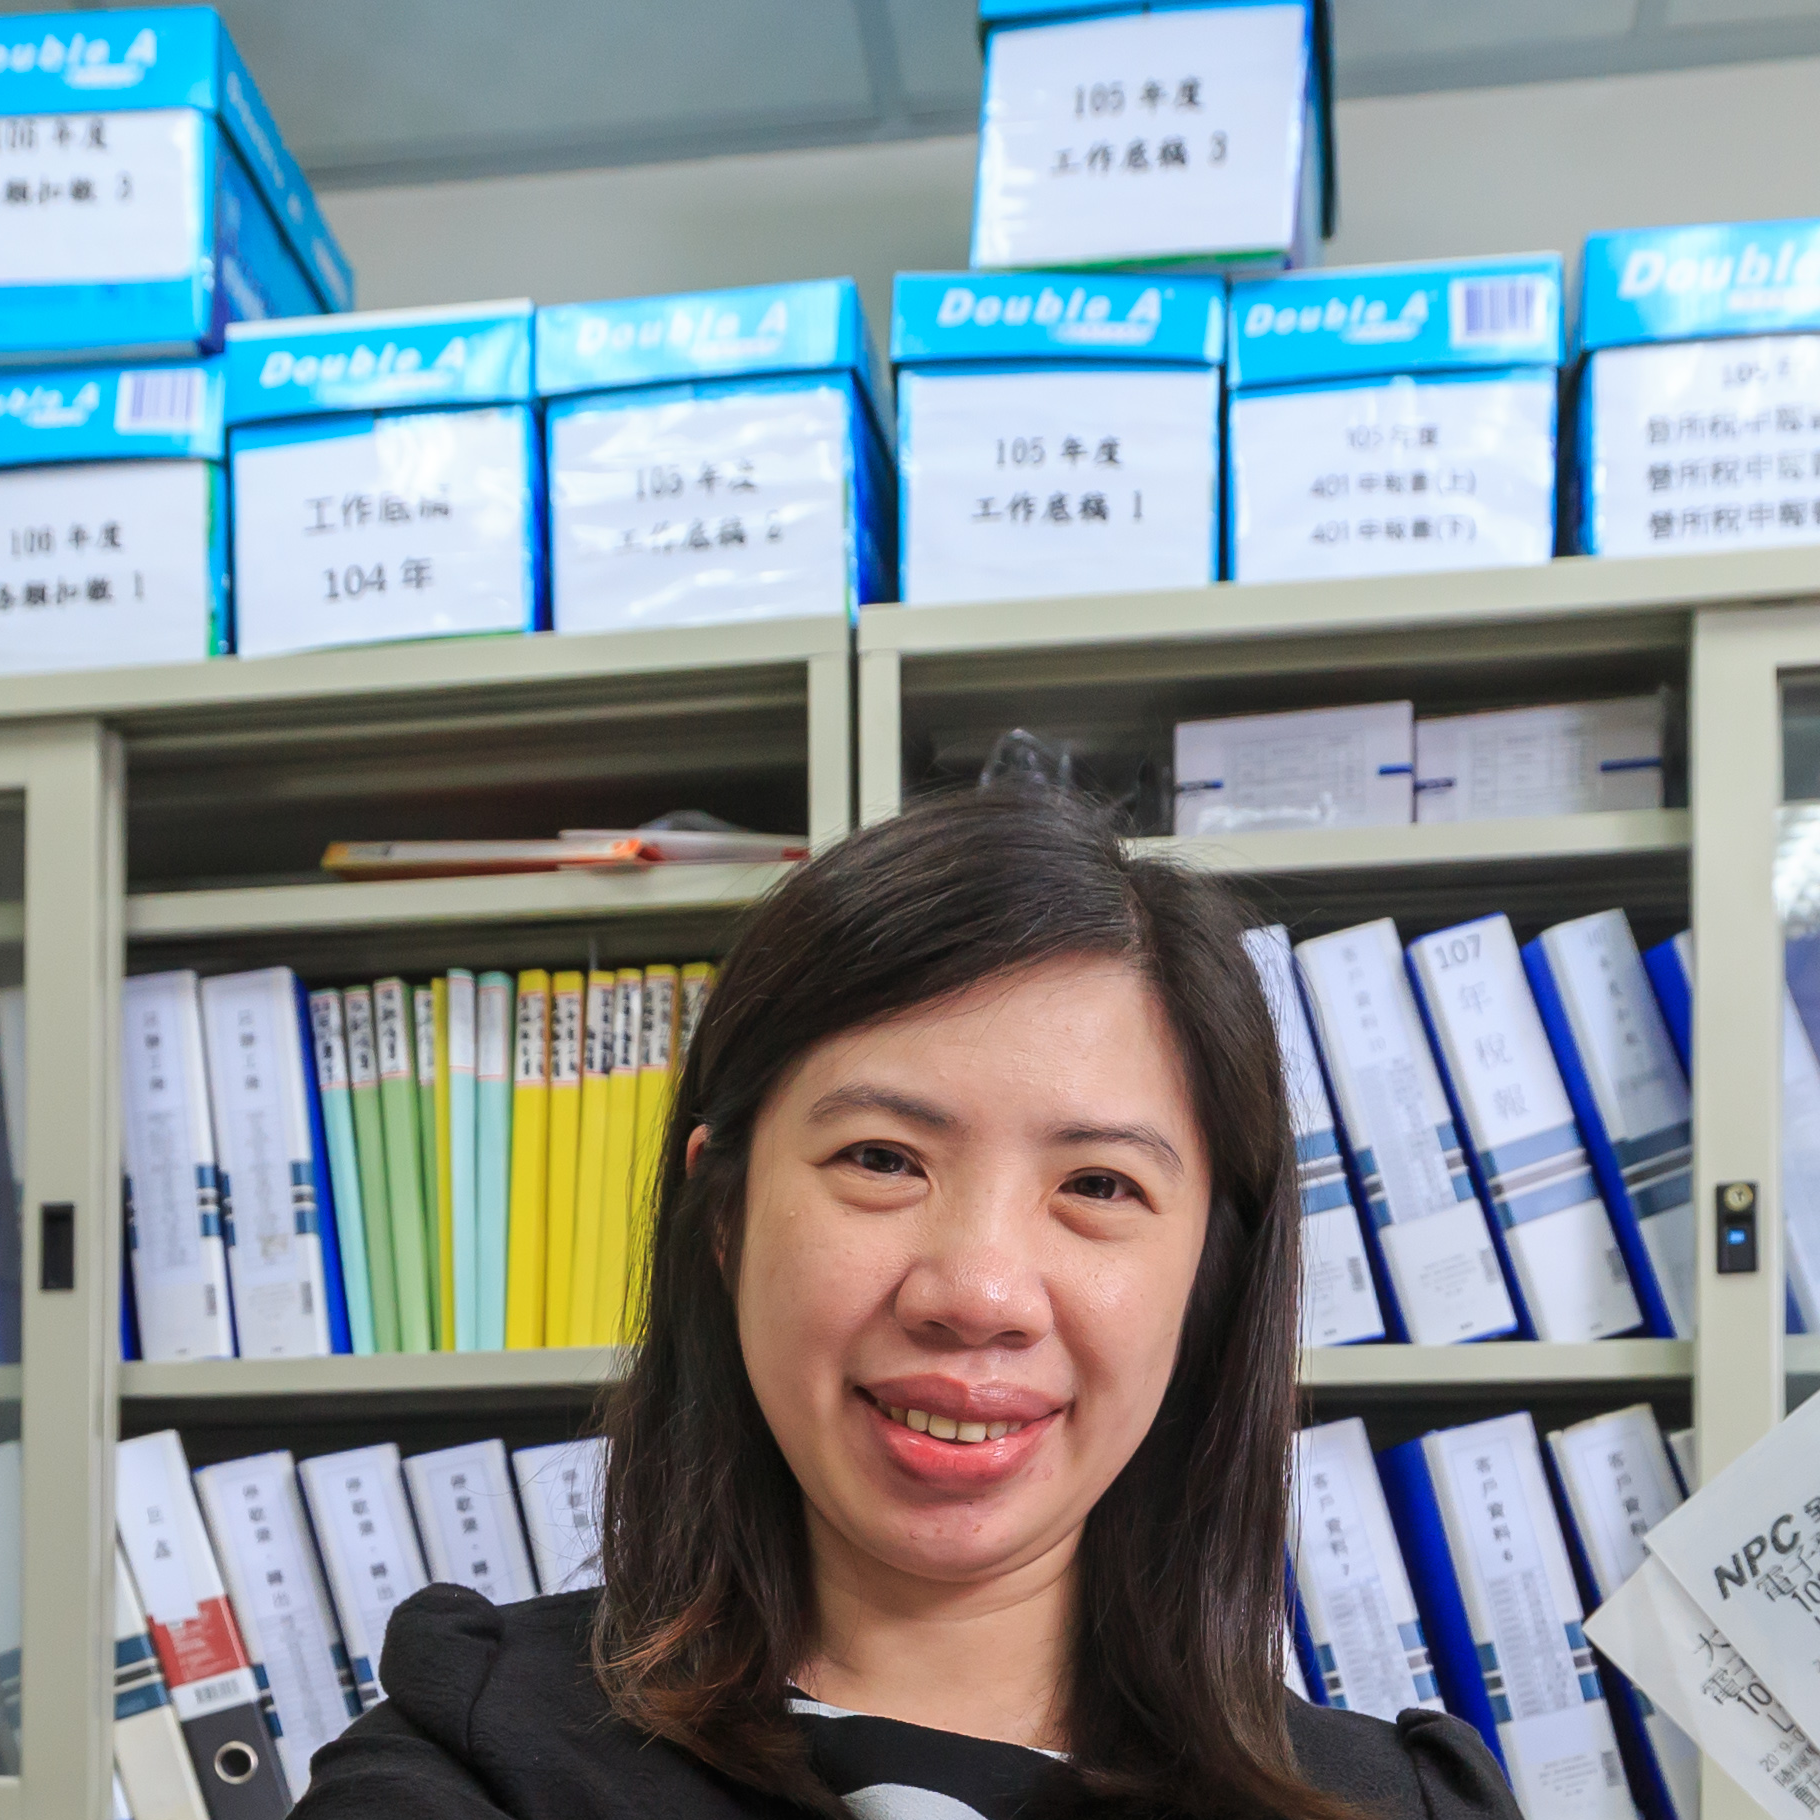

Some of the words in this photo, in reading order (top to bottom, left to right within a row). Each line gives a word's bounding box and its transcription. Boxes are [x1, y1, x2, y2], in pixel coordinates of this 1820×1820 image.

[125, 28, 158, 67] A
[1073, 82, 1126, 117] 105
[1620, 244, 1811, 298] Double
[577, 306, 739, 353] Double
[756, 299, 788, 336] A
[937, 288, 1115, 328] Double
[1126, 287, 1162, 323] A
[1243, 297, 1381, 338] Double
[1392, 290, 1429, 320] A
[259, 342, 421, 388] Double
[437, 335, 467, 367] A
[72, 382, 100, 412] A
[994, 436, 1047, 467] 105
[972, 492, 1109, 523] 工作底稿
[322, 562, 387, 601] 104
[399, 556, 435, 590] 年
[1434, 933, 1484, 971] 107
[1712, 1513, 1802, 1600] NPC
